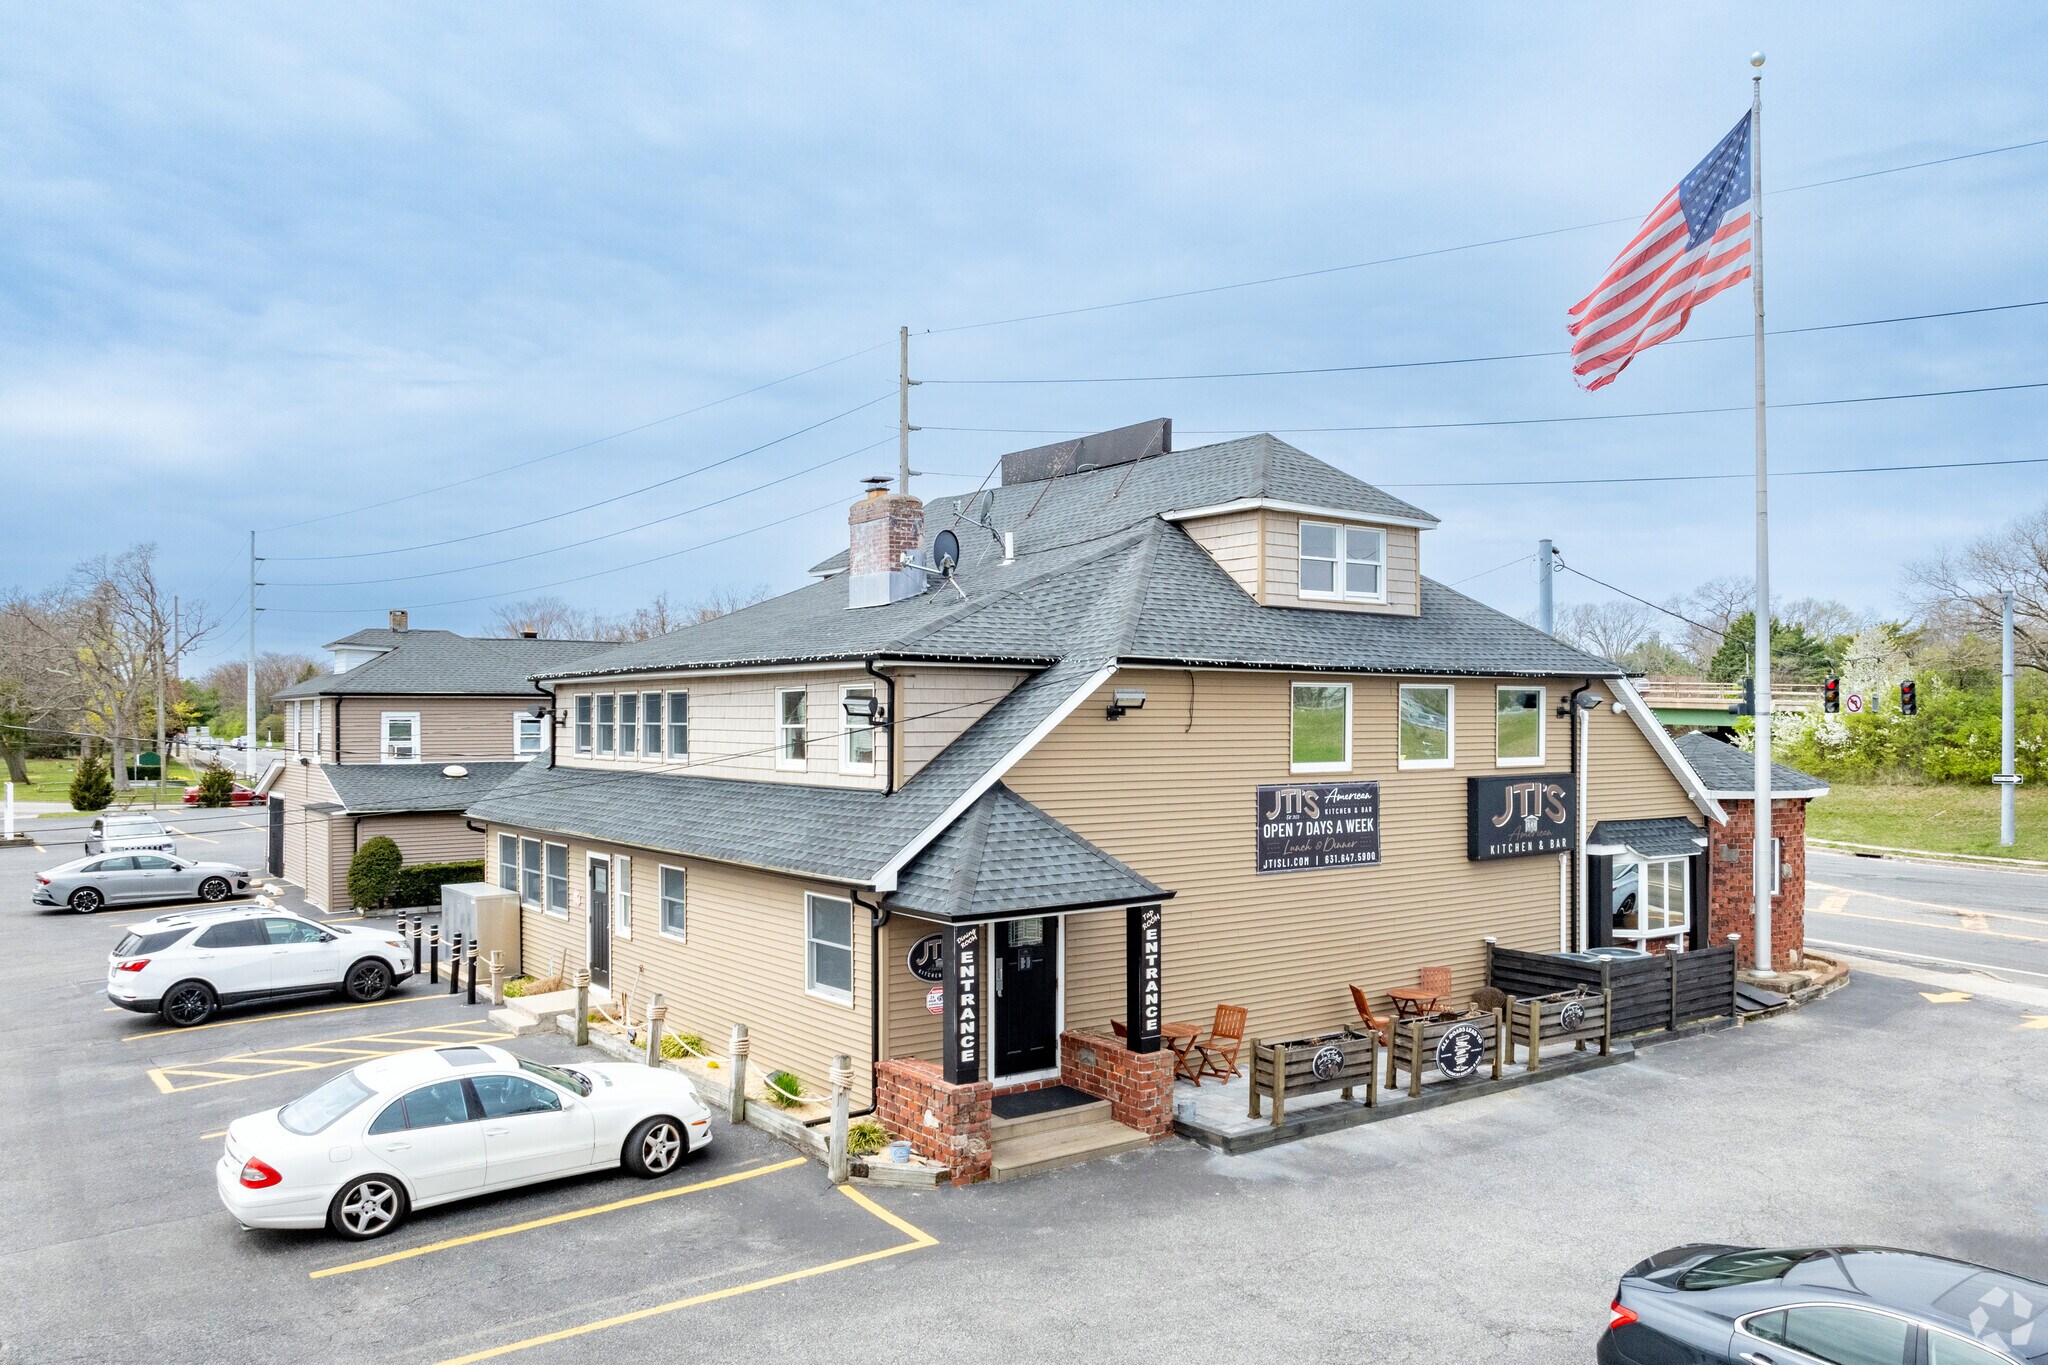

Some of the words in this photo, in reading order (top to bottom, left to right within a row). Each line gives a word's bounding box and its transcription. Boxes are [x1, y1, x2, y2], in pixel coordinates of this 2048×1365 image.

[1266, 788, 1320, 820] JTI'S
[1324, 787, 1372, 804] American
[1324, 807, 1351, 815] KITCHEN
[1491, 783, 1566, 827] JTI'S
[1263, 823, 1293, 838] OPEN
[1296, 822, 1303, 836] 7
[1306, 820, 1333, 836] DAYS
[1336, 820, 1343, 834] A
[1345, 818, 1374, 833] WEEK
[1508, 825, 1552, 841] American
[1283, 839, 1312, 856] Lunch
[1315, 841, 1322, 849] &
[1323, 837, 1358, 852] Dinner
[1490, 842, 1533, 855] KITCHEN
[1539, 840, 1544, 849] &
[1550, 838, 1567, 849] BAR
[1263, 856, 1309, 869] JTISLI.COM
[1324, 852, 1376, 864] 631.647.5900
[1142, 910, 1154, 921] Tap
[1142, 913, 1160, 931] ROOM
[956, 928, 976, 944] Dining
[960, 934, 978, 949] ROOM
[1145, 929, 1158, 1031] ENTRANCE
[960, 951, 975, 1062] ENTRANCE
[1441, 1038, 1450, 1051] ALL
[1448, 1027, 1465, 1039] ROADS
[1465, 1027, 1478, 1037] LEAD
[1476, 1034, 1483, 1044] TO
